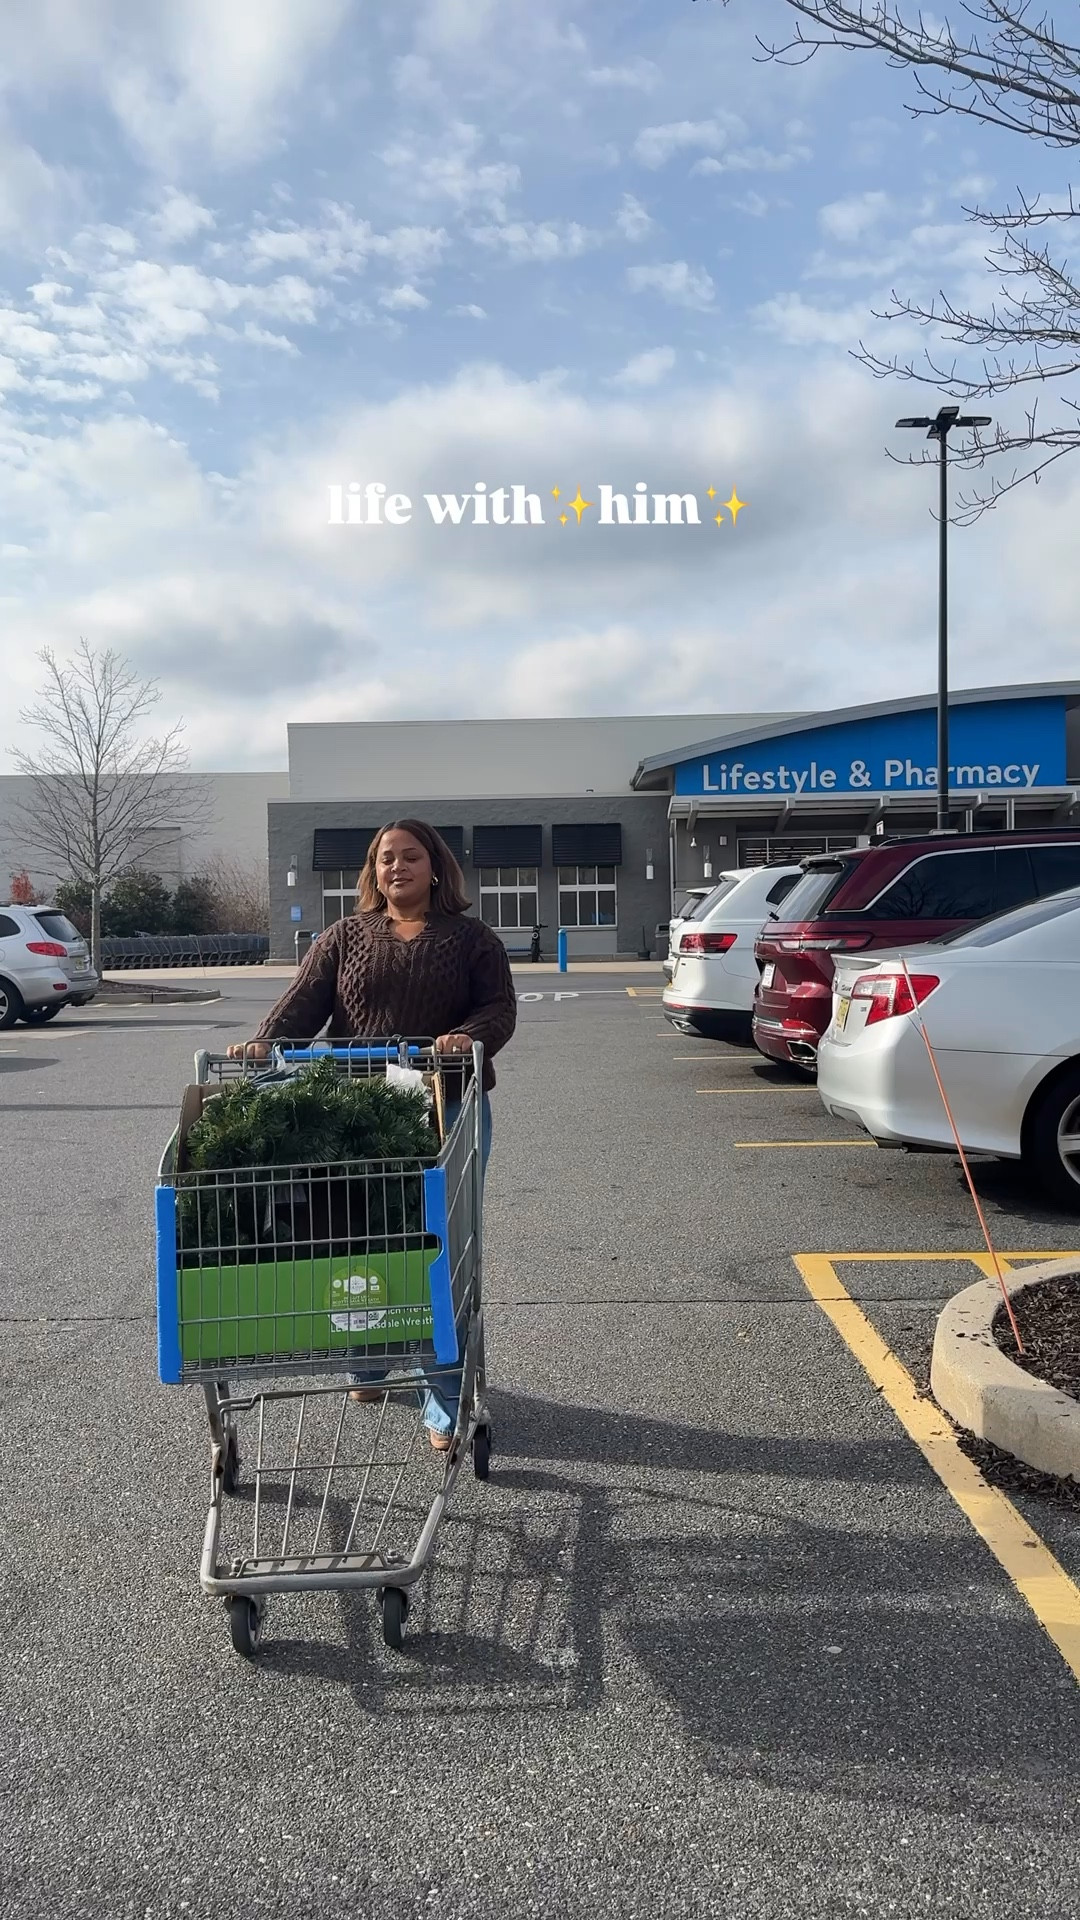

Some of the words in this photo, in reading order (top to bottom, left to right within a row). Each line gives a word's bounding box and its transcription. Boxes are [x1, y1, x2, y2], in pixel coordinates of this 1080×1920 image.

[702, 761, 837, 794] Lifestyle
[848, 759, 872, 789] &
[517, 992, 580, 1002] OP
